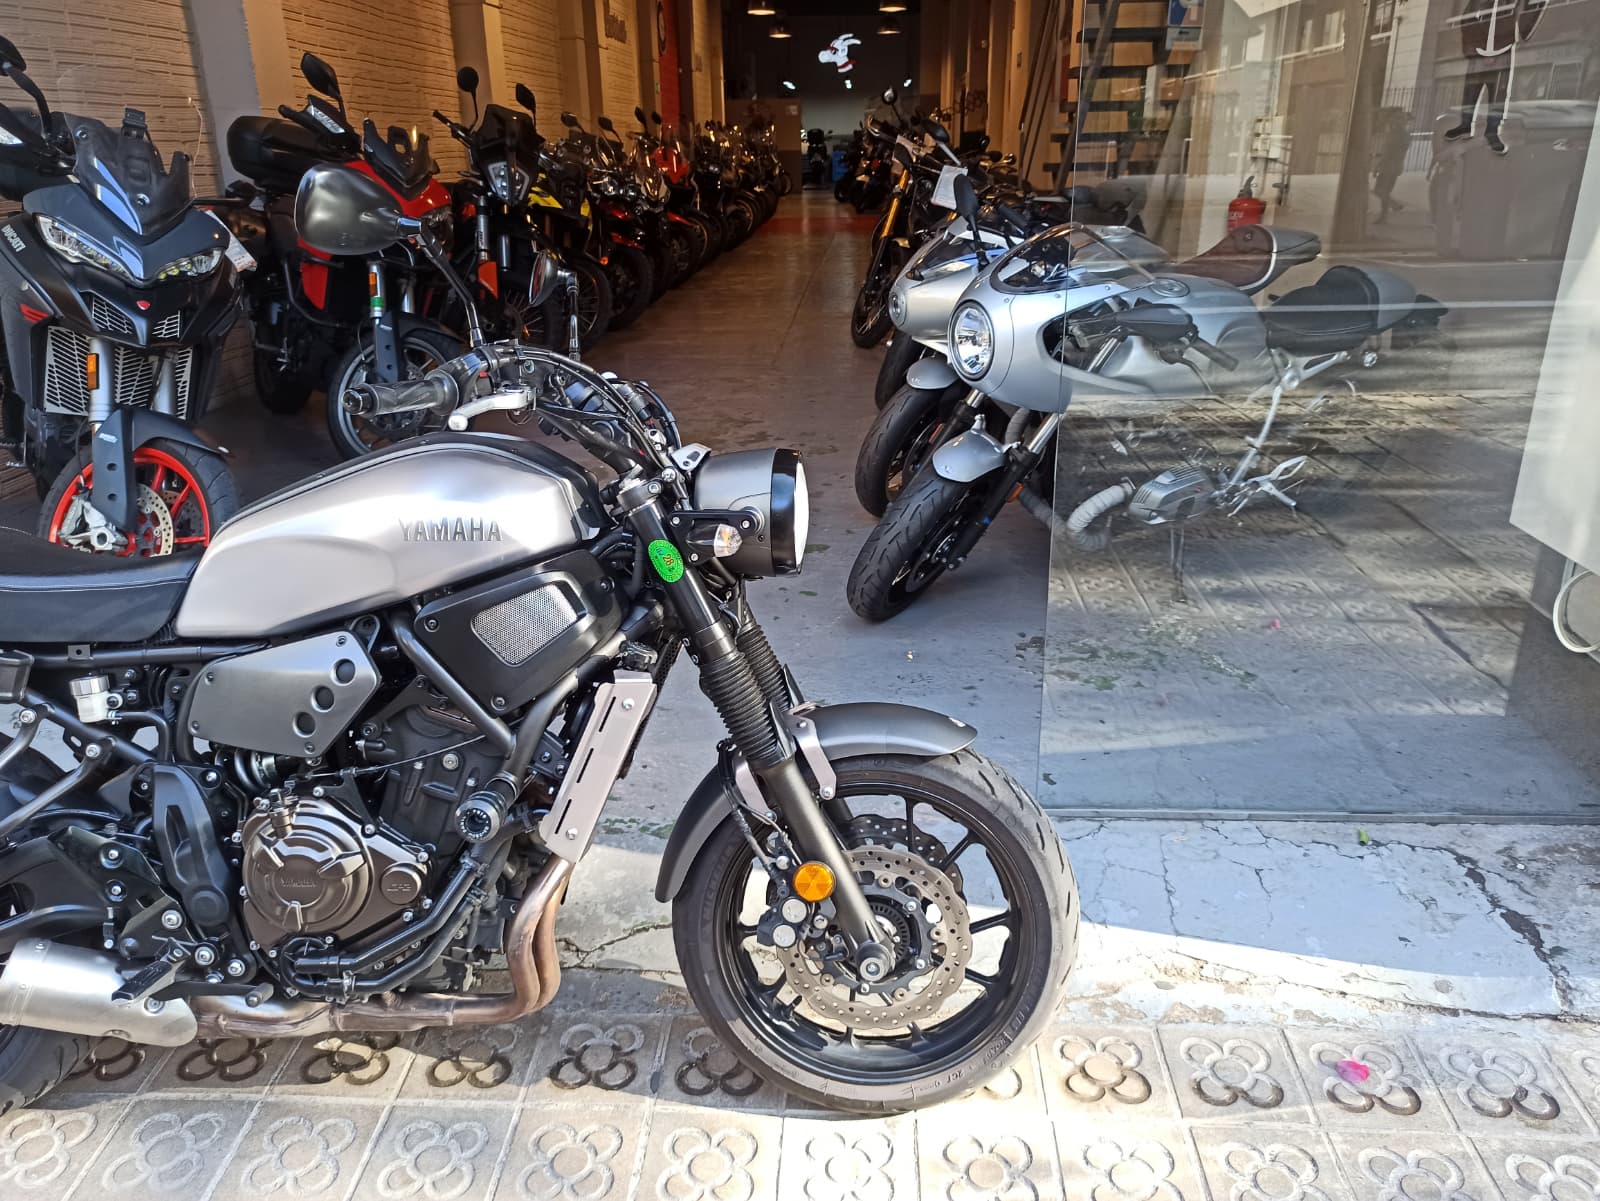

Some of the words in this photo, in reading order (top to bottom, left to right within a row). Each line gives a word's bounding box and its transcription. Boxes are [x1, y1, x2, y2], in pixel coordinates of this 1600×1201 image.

[1, 224, 26, 252] DUCATI
[399, 517, 503, 542] YAMAHA
[662, 553, 675, 566] 28
